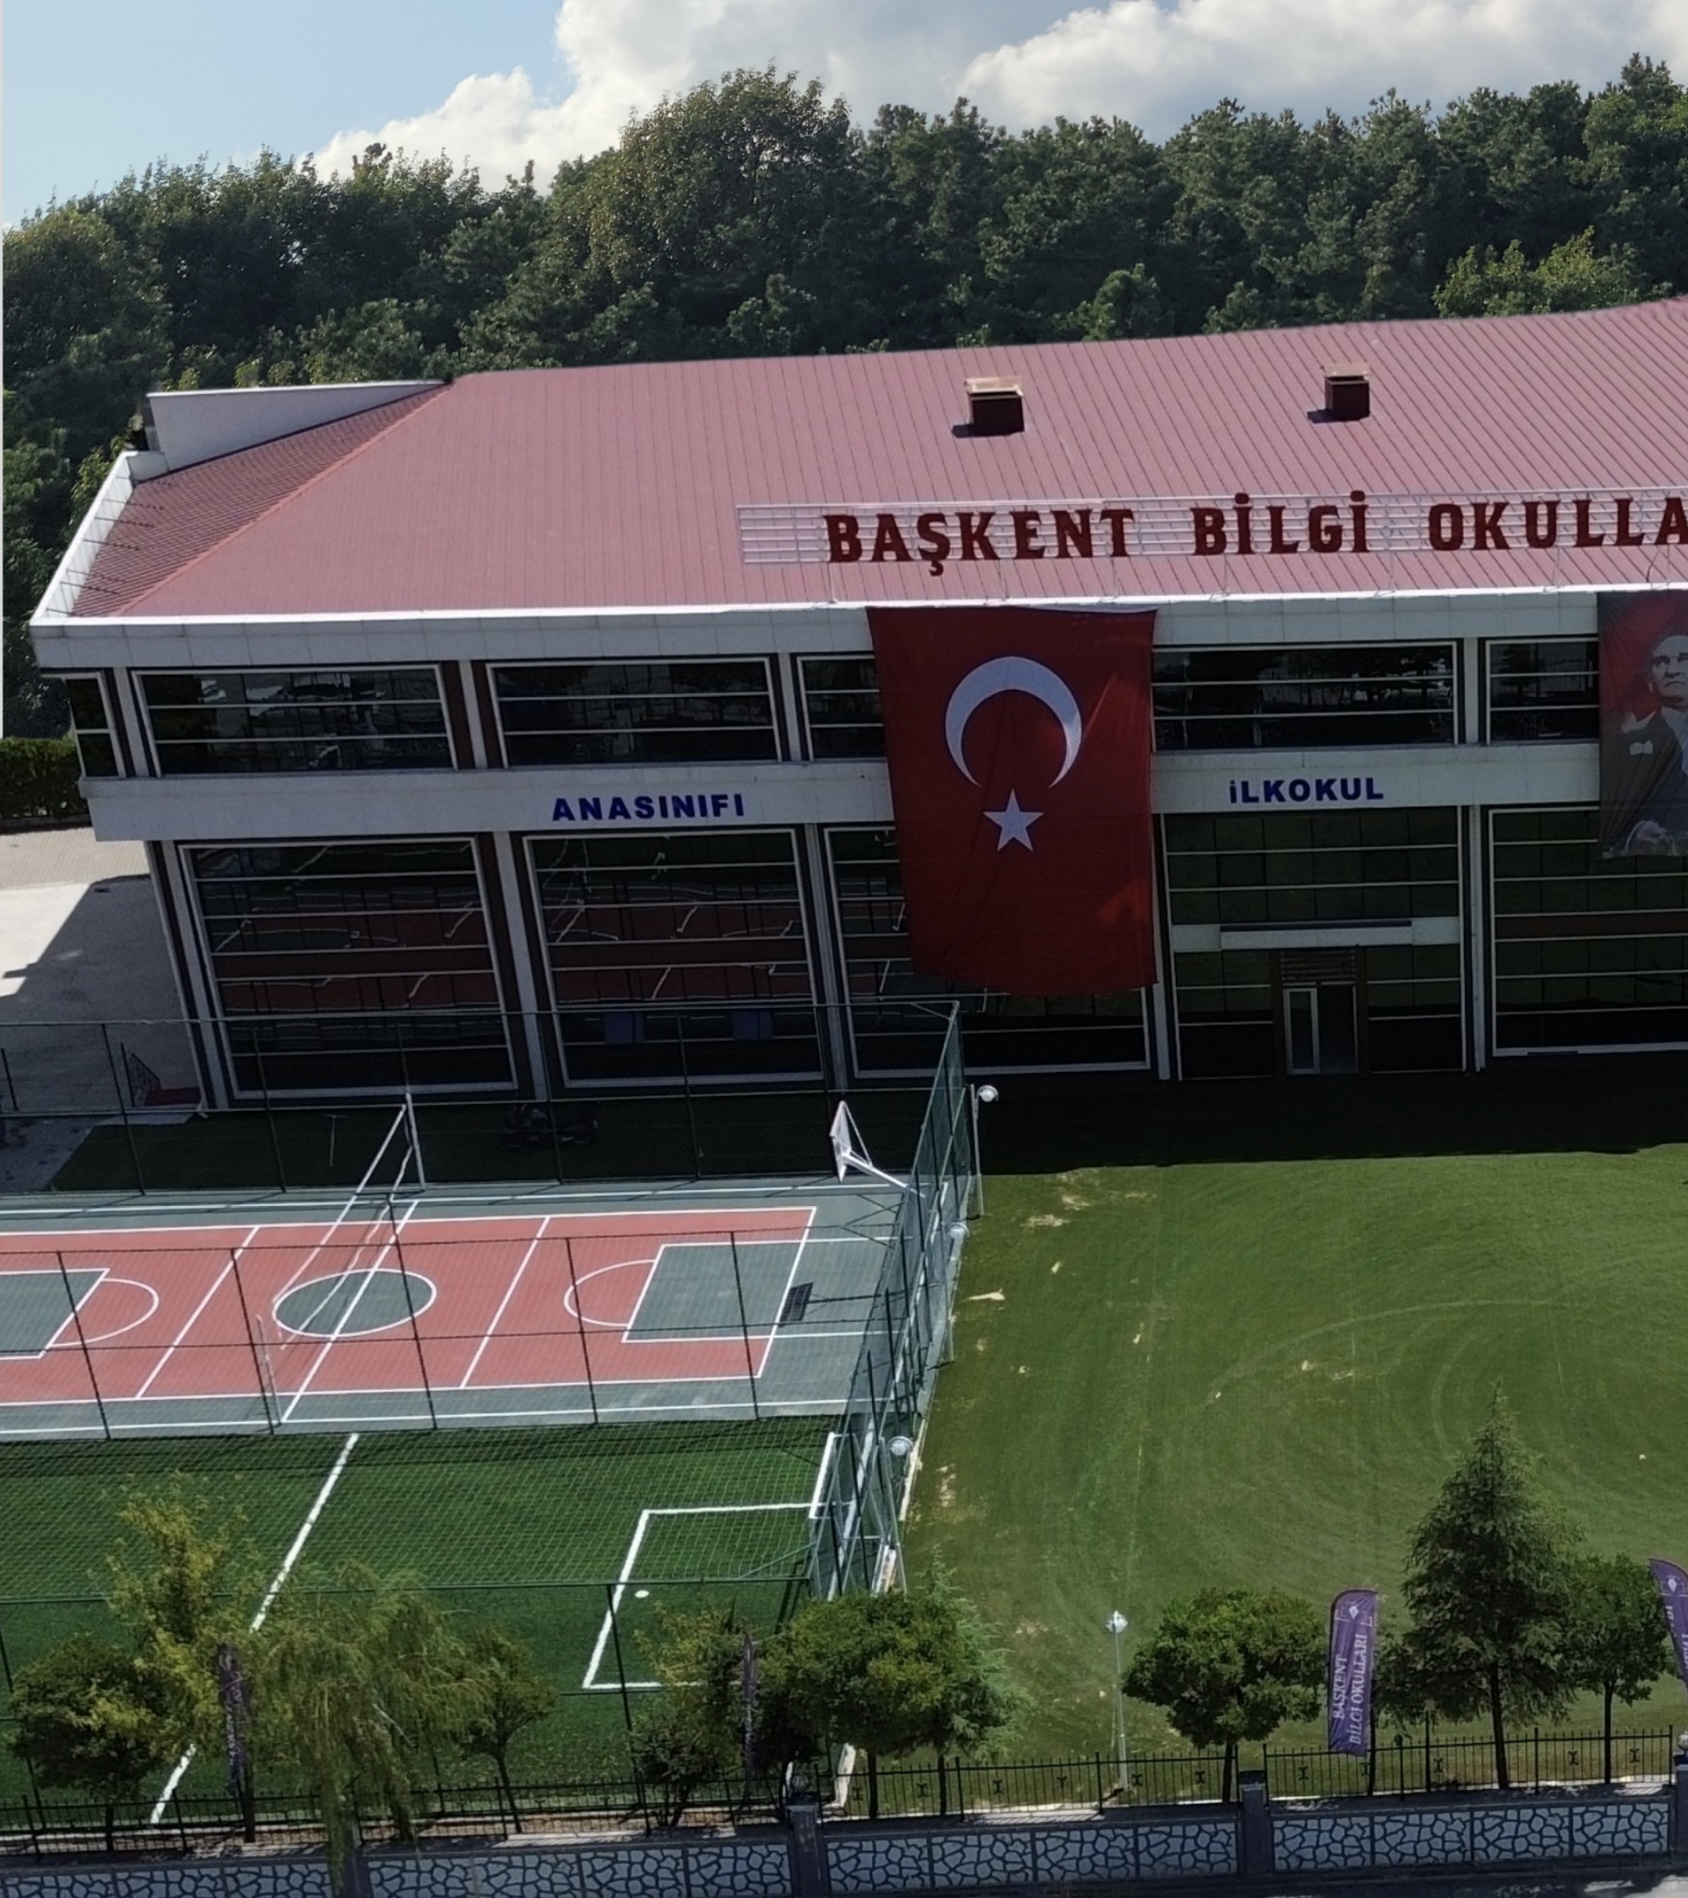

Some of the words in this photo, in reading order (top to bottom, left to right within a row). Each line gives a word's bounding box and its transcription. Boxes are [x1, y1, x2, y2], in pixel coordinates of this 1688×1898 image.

[823, 508, 1136, 577] BAŞKENT
[1190, 490, 1371, 556] BİLGİ
[552, 793, 746, 822] ANASINIFI
[1229, 777, 1385, 804] İLKOKUL
[1332, 1653, 1348, 1720] BAŞKENT
[1352, 1633, 1368, 1704] OKULLARI
